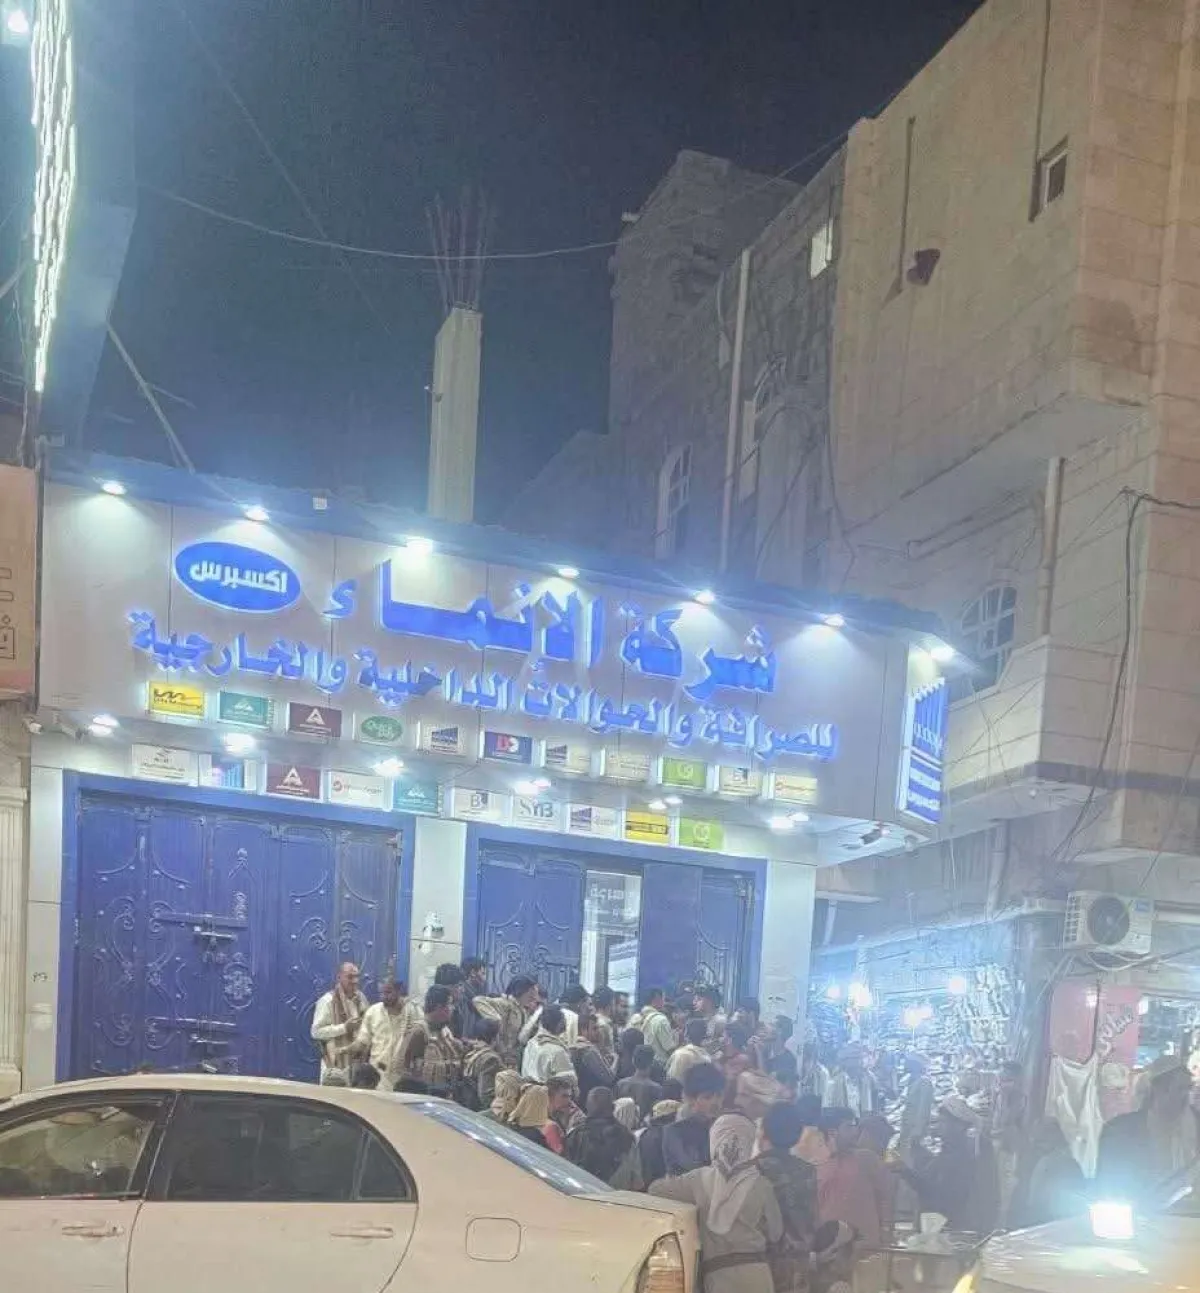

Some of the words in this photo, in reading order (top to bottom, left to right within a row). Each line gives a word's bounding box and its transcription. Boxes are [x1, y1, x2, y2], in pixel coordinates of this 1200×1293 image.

[189, 559, 289, 594] اكسبرس
[128, 611, 348, 694] والخارجية
[353, 649, 517, 710] الداخلية
[620, 602, 778, 702] شركة
[520, 681, 692, 749] والحوالات
[699, 703, 839, 761] للصرافة
